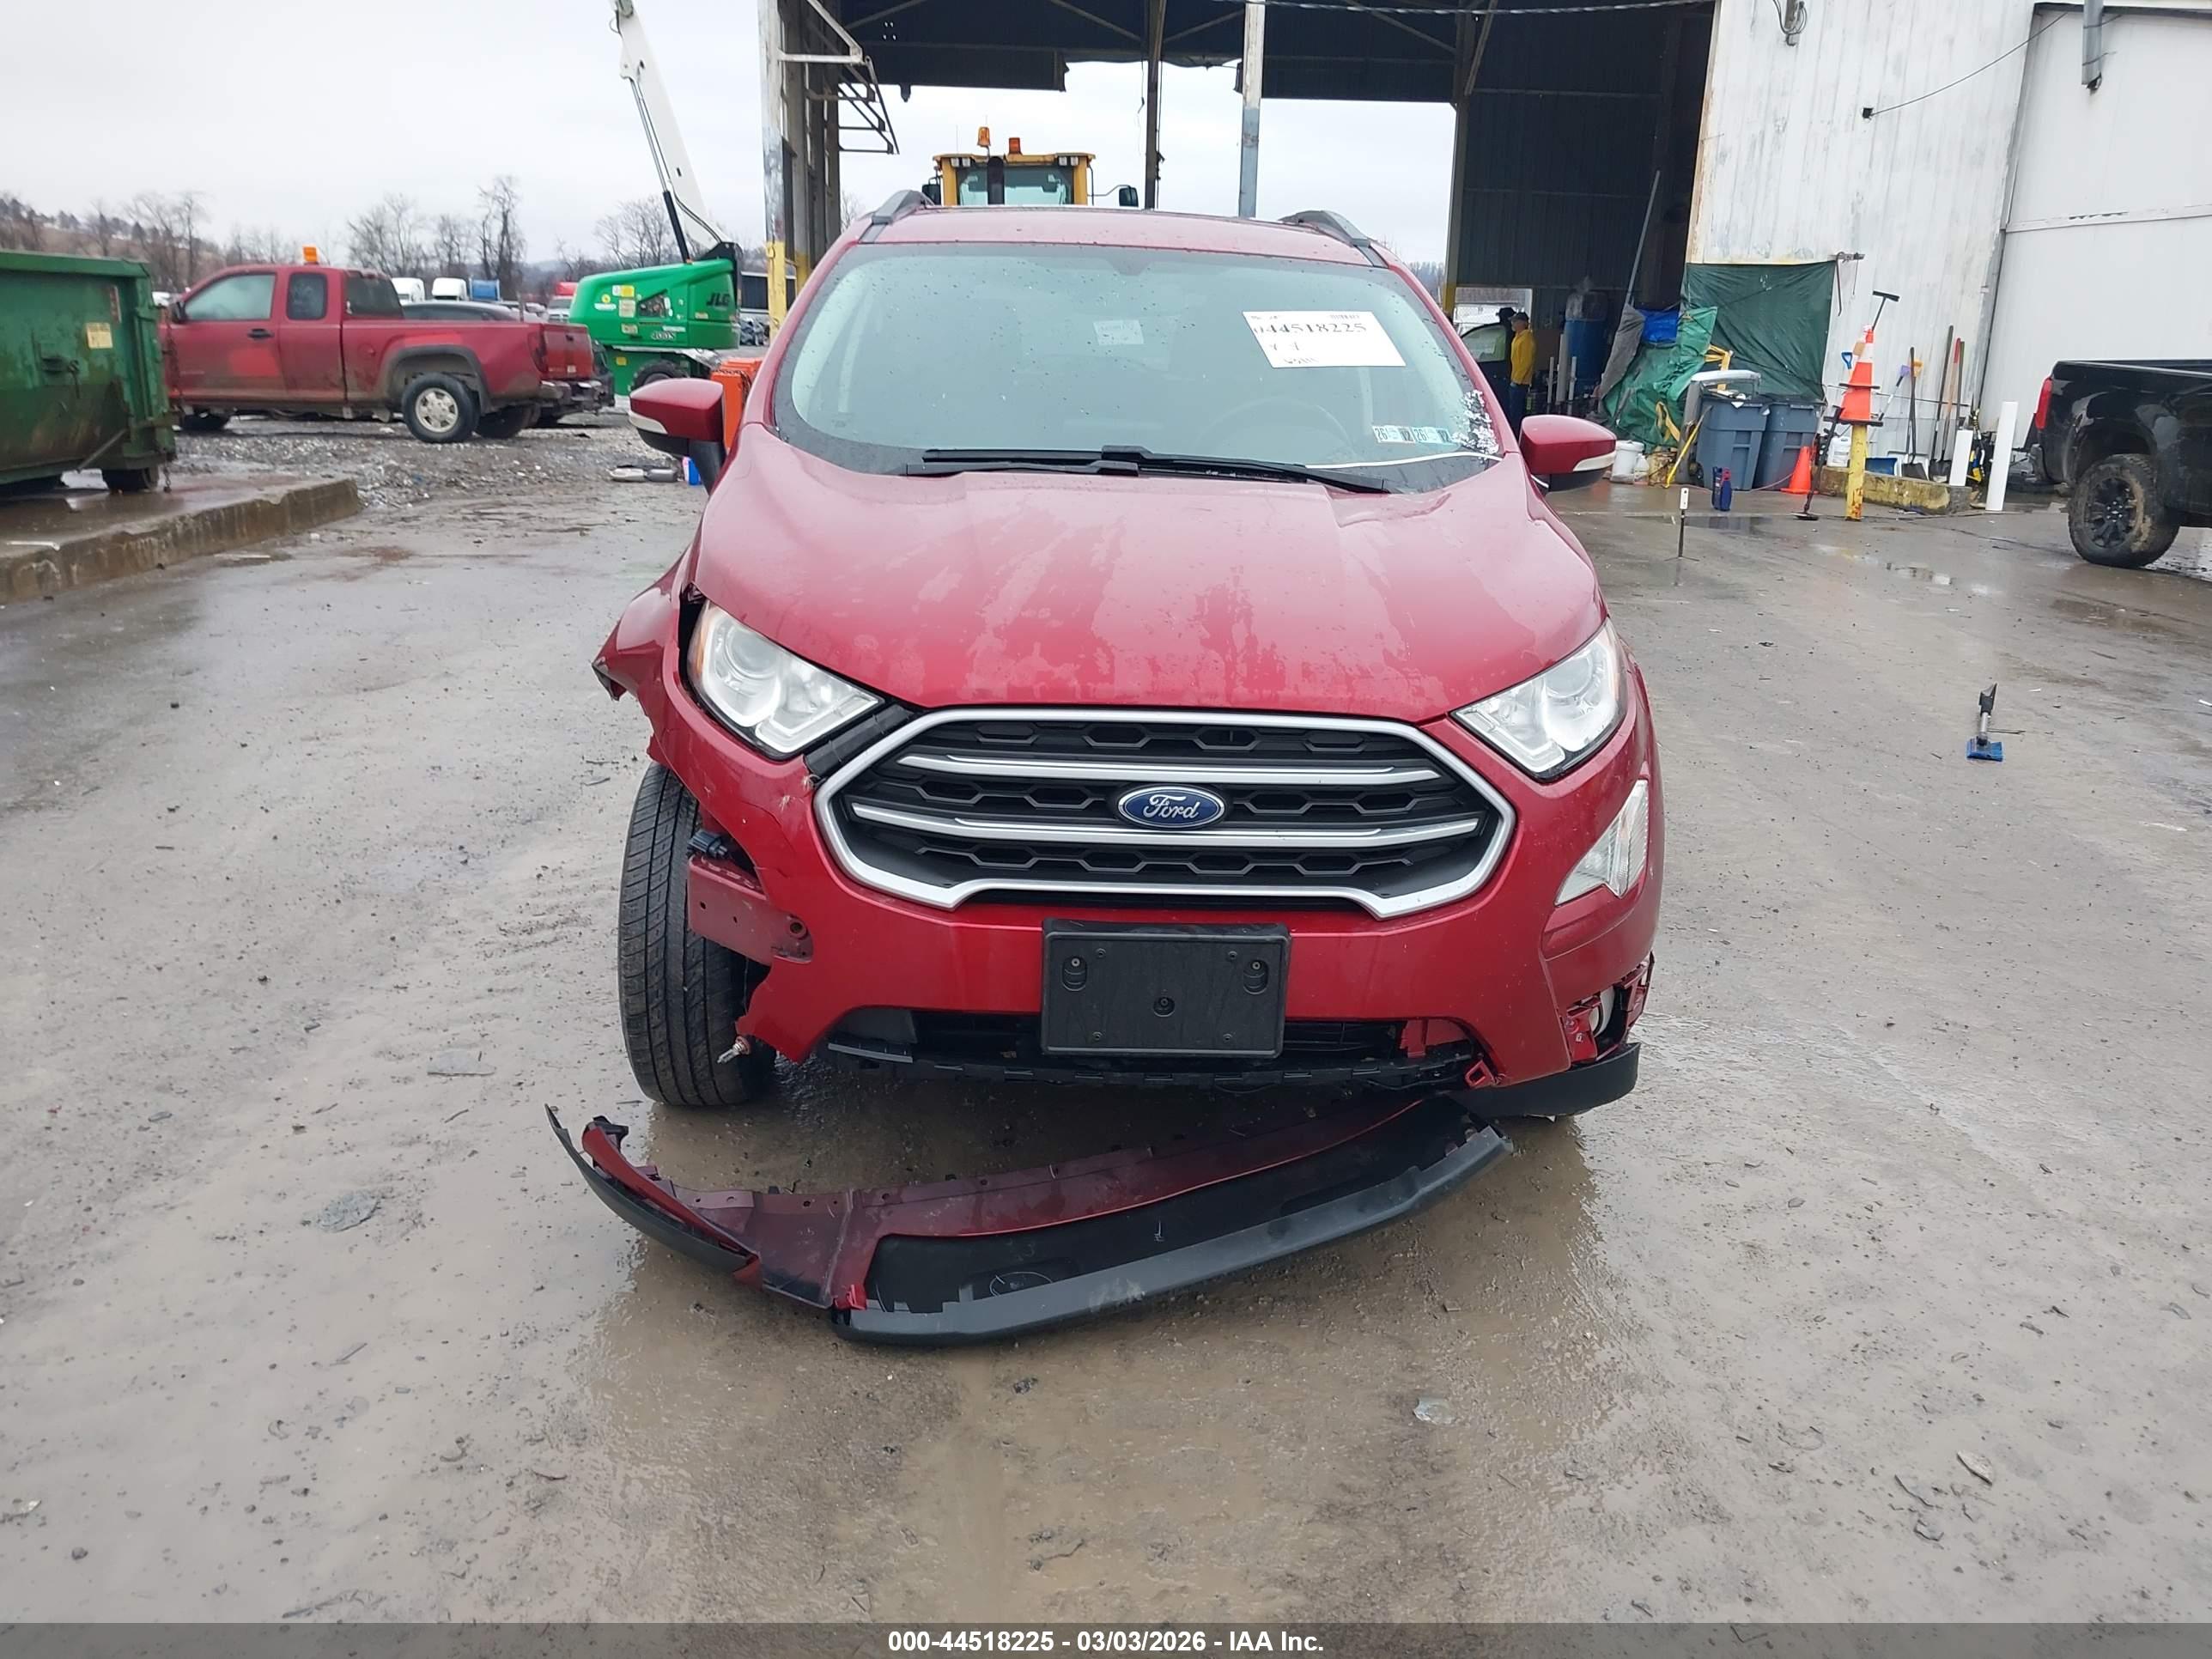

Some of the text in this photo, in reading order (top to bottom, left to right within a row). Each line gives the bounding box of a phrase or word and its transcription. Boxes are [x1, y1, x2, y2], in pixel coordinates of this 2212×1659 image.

[1374, 428, 1389, 441] 26
[1413, 428, 1427, 441] 26
[1143, 793, 1201, 819] Ford
